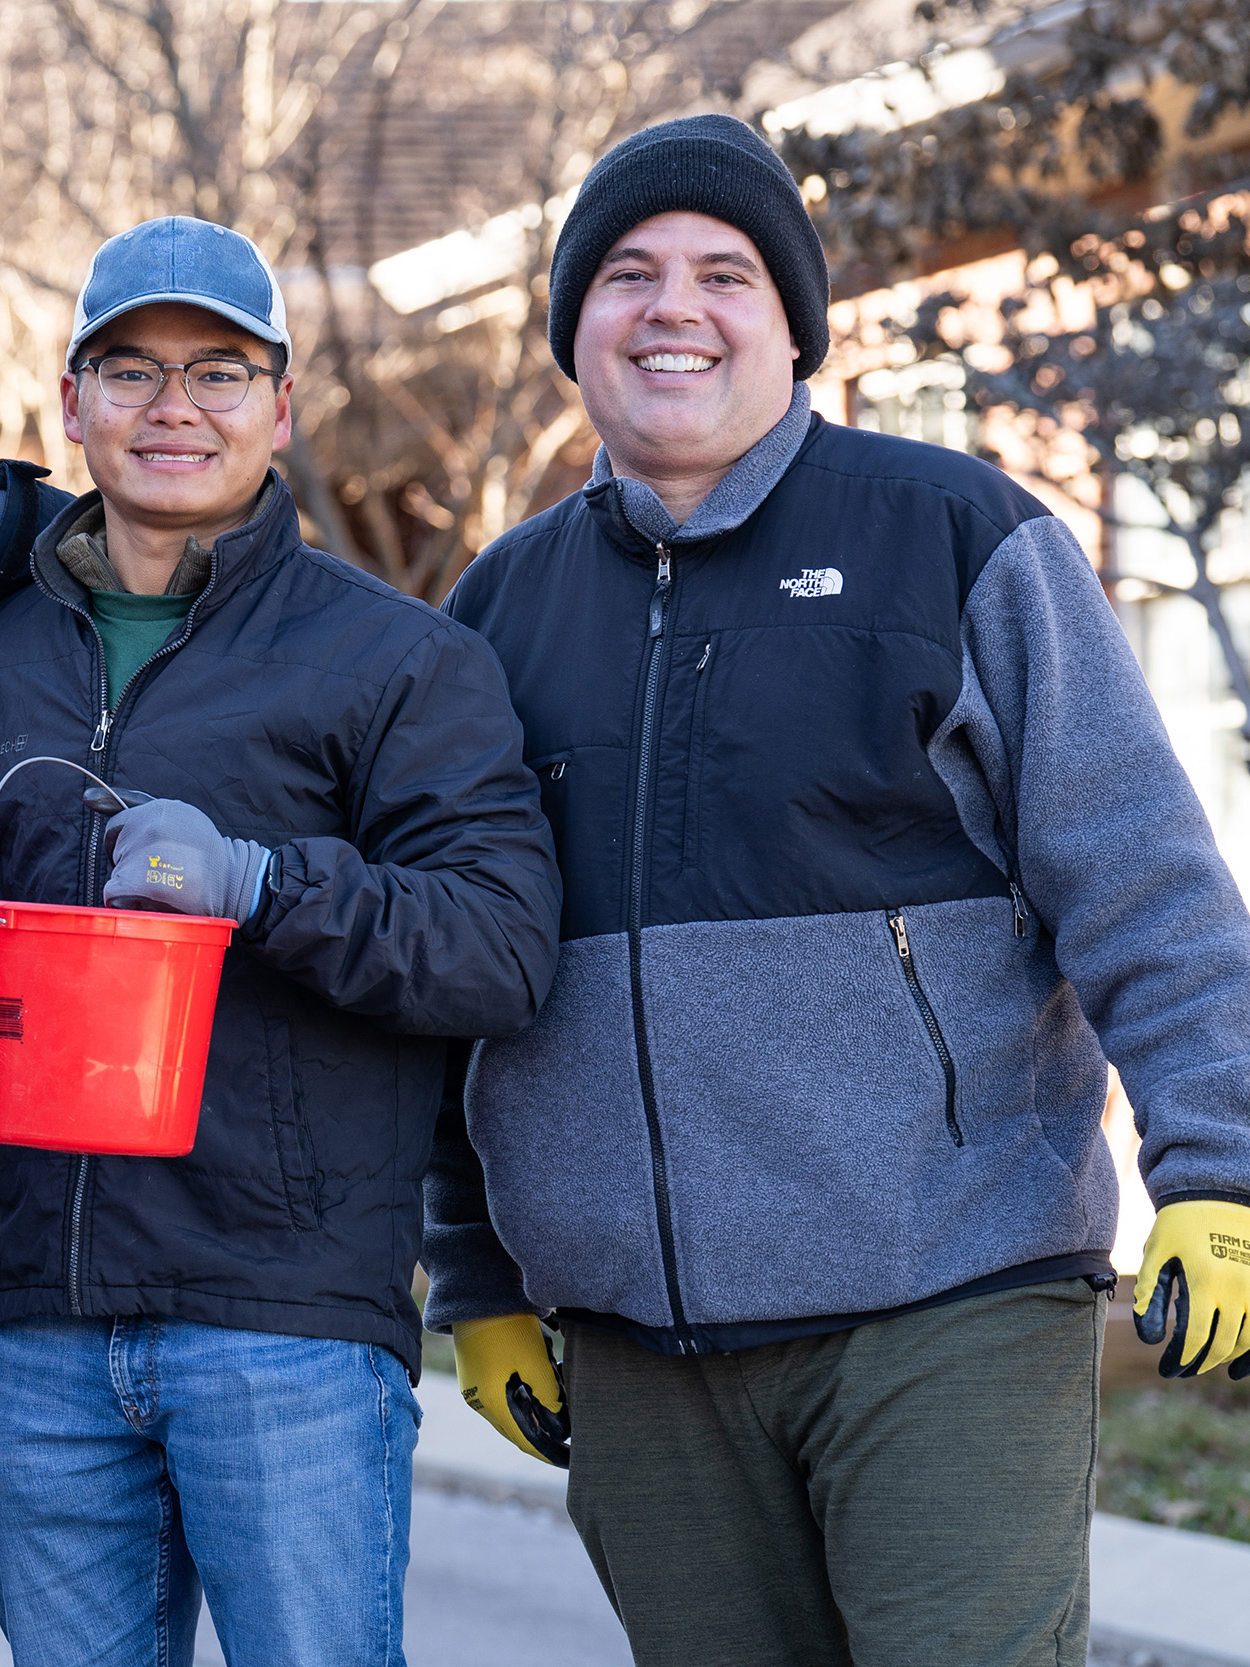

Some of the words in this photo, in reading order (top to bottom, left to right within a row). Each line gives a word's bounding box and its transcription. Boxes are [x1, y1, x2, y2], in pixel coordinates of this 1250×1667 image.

[801, 569, 826, 578] THE
[779, 578, 823, 589] NORTH
[790, 588, 821, 597] FACE
[1209, 1232, 1240, 1248] FIRM
